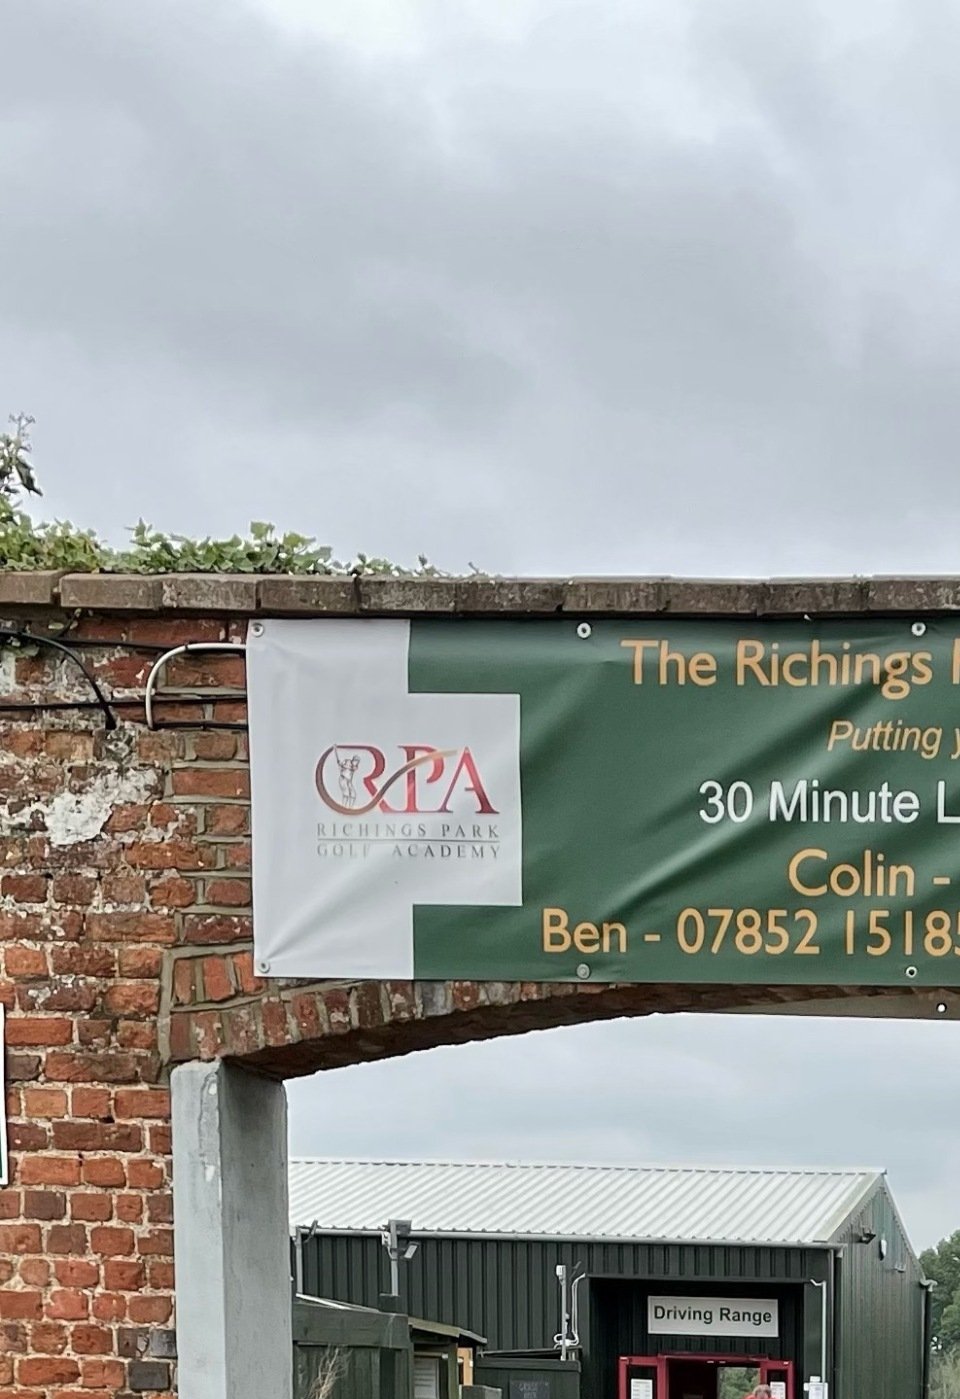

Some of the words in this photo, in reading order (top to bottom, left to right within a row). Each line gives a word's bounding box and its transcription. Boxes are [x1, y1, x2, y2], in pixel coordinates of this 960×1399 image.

[621, 639, 717, 686] The
[736, 640, 932, 698] Richings
[827, 720, 942, 759] Putting
[699, 780, 752, 824] 30
[768, 779, 920, 824] Minute
[317, 823, 427, 837] RICHINGS
[441, 824, 500, 839] PARK
[317, 843, 369, 857] GOLF
[392, 844, 500, 859] ACADEMY
[787, 849, 915, 898] Colin
[542, 908, 627, 953] Ben
[676, 909, 820, 955] 07852
[654, 1305, 713, 1325] Driving
[719, 1307, 772, 1326] Range
